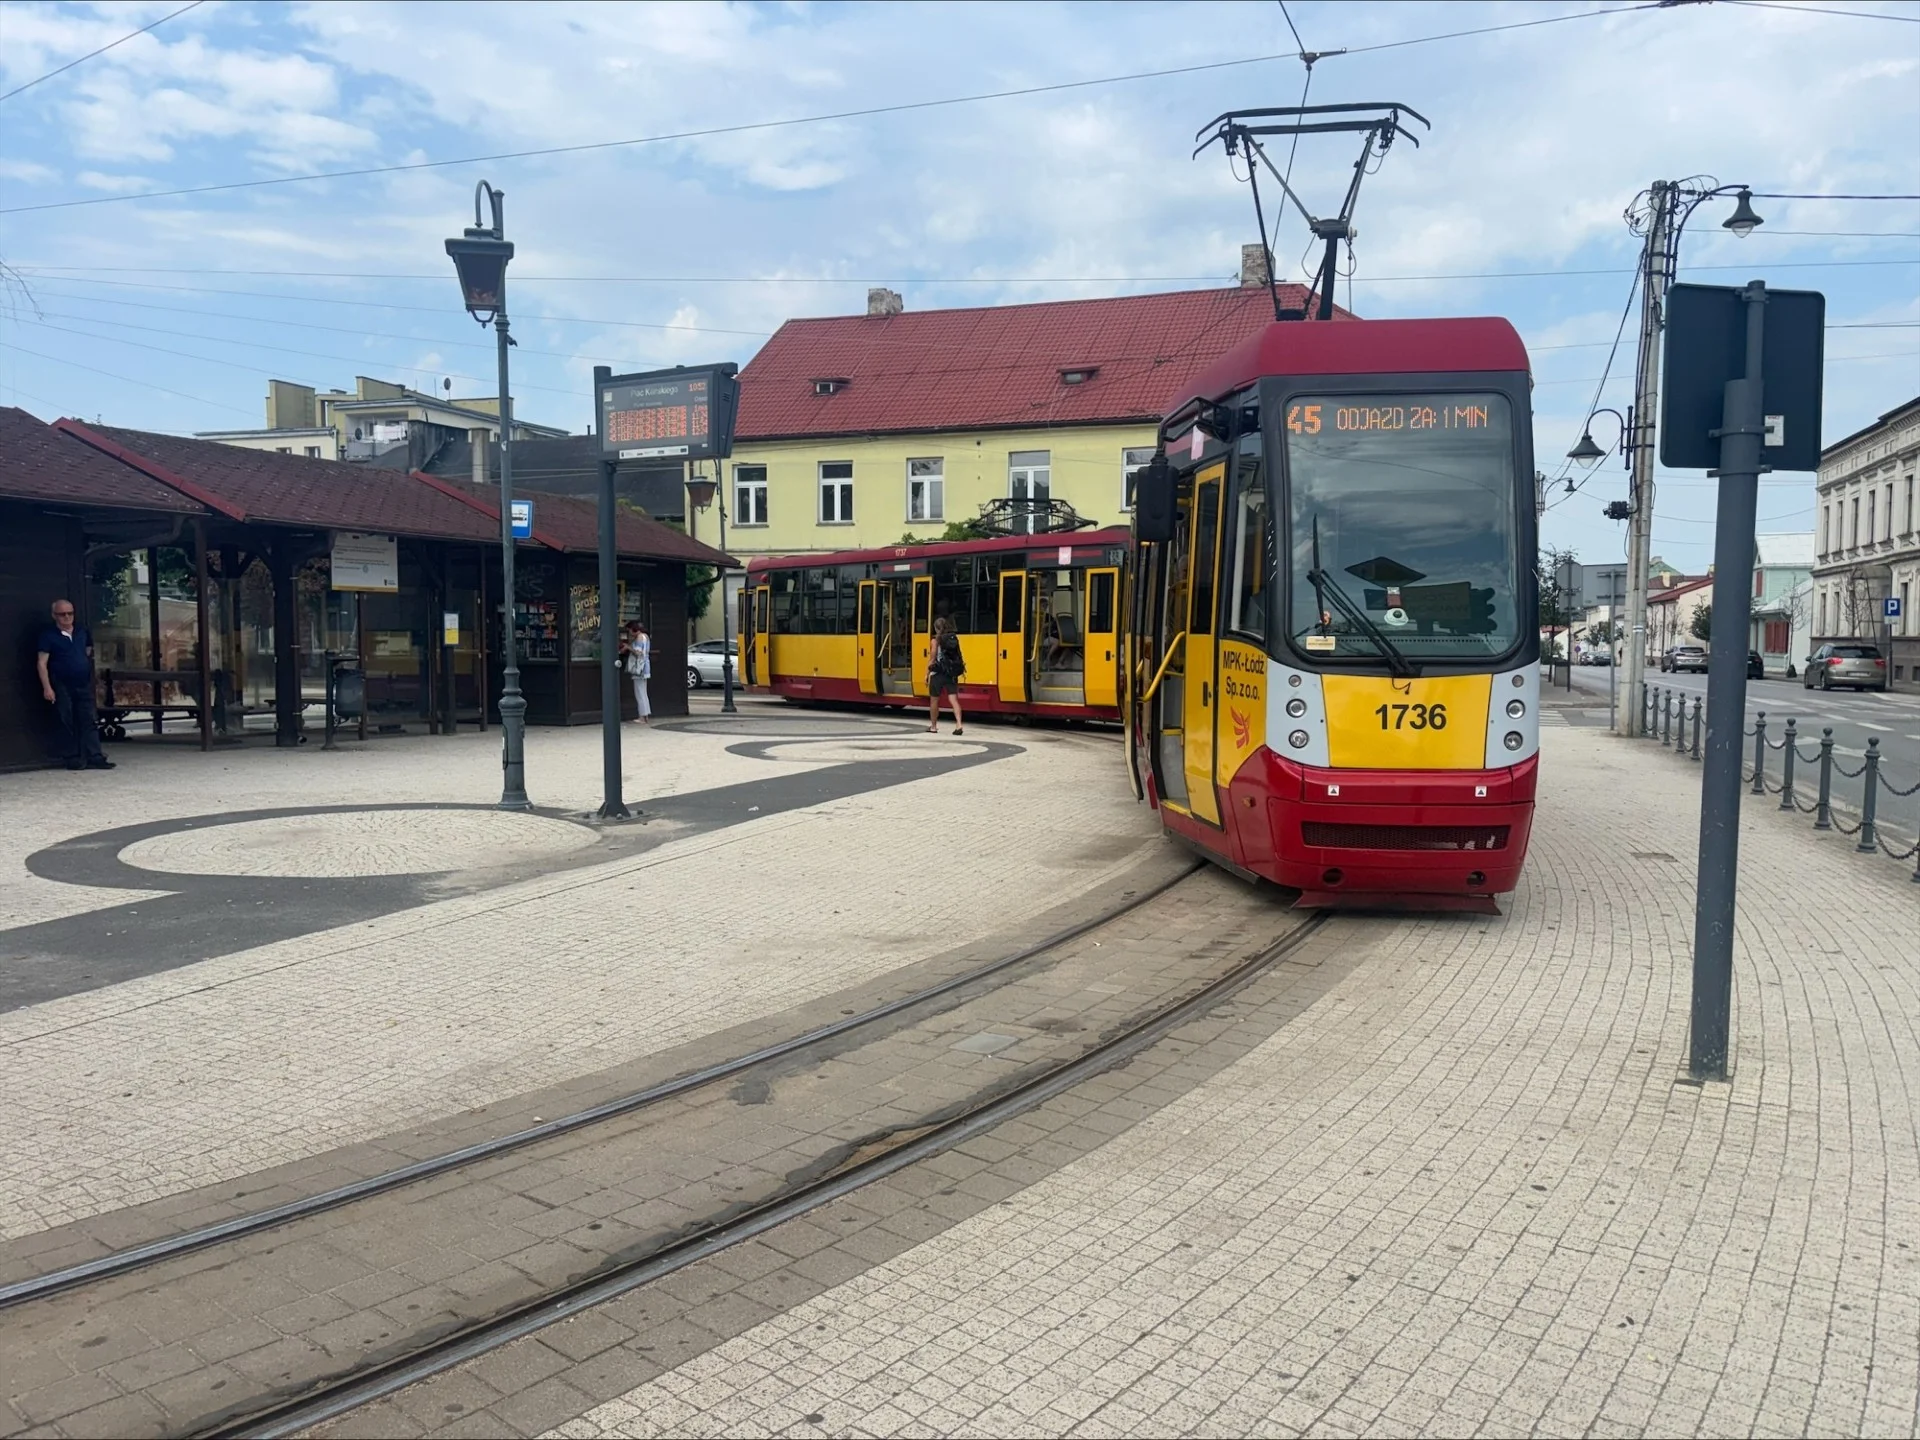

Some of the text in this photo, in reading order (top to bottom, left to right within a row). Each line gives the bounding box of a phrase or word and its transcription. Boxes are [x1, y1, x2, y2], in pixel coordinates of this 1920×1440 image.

[1287, 405, 1321, 434] 45
[1337, 408, 1404, 430] ODJAZD
[1443, 406, 1449, 428] 1
[1454, 405, 1487, 428] MIN
[575, 595, 599, 615] prasa
[1888, 600, 1898, 614] P
[578, 615, 601, 631] bilety
[1223, 651, 1265, 675] MPK-Łódź
[1226, 676, 1238, 700] Sp.
[1375, 703, 1447, 730] 1736
